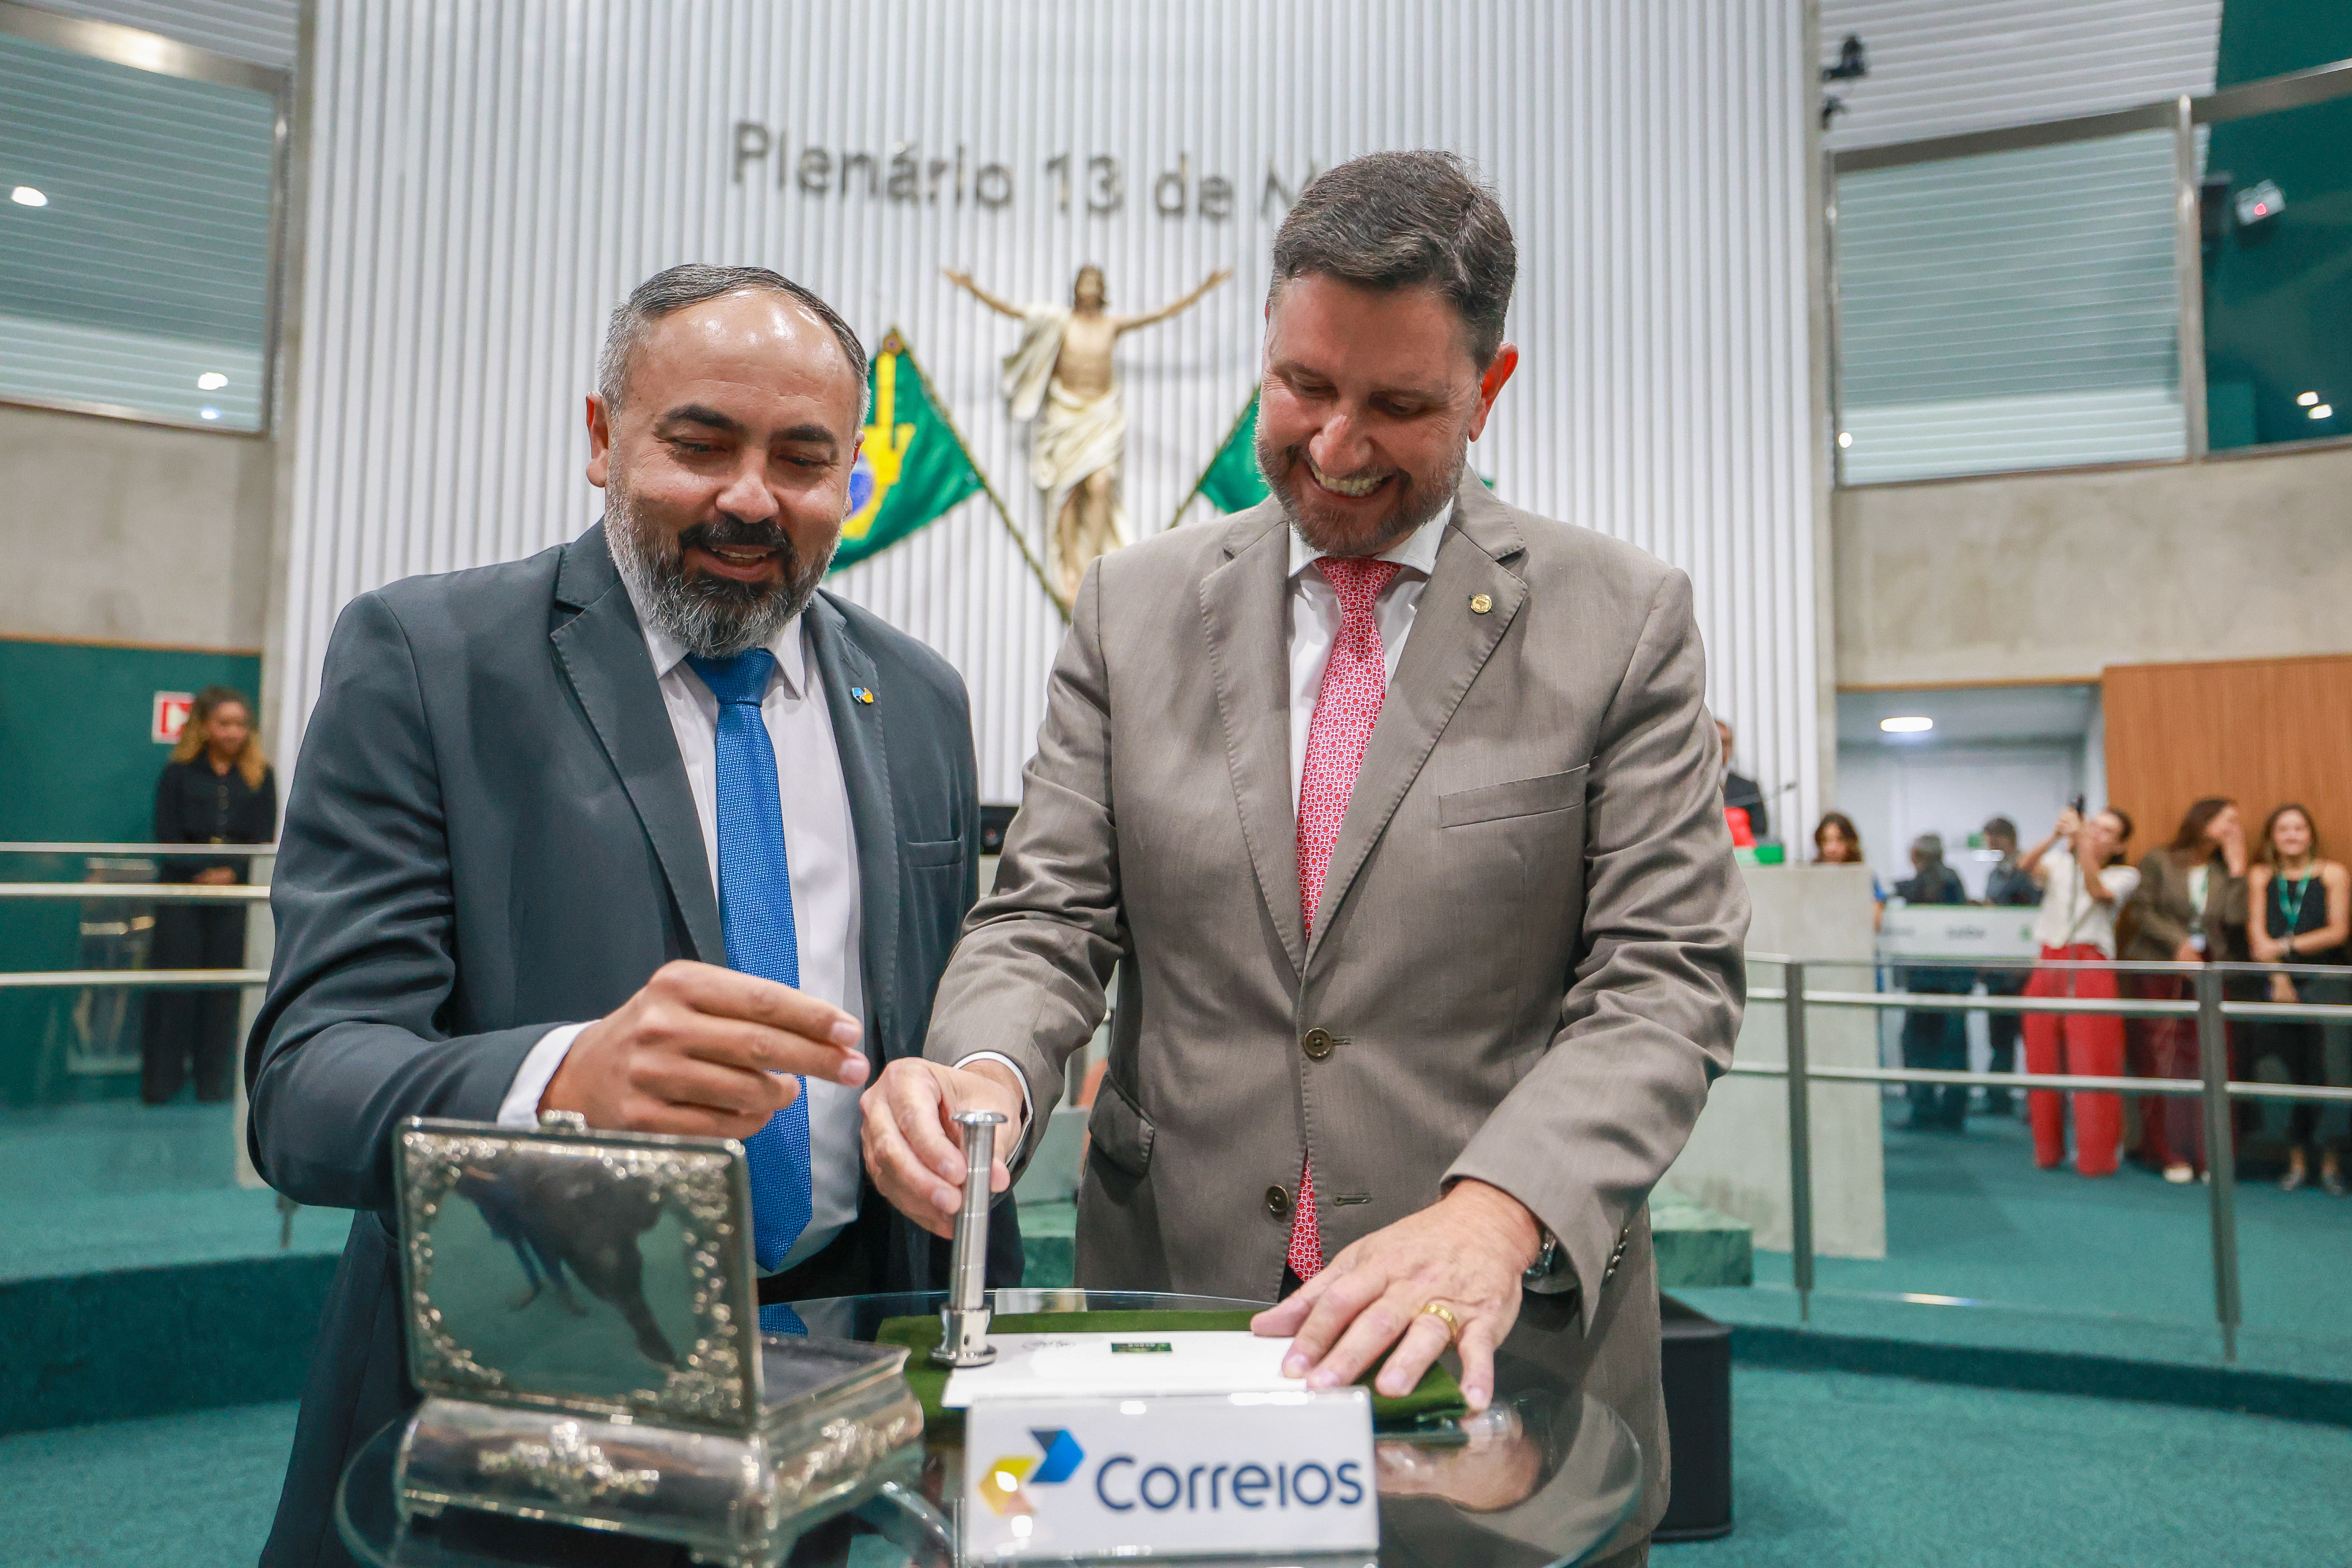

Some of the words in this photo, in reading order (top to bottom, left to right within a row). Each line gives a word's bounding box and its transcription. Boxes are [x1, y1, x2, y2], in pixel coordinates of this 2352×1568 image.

[732, 121, 1012, 208] Plenário
[1045, 154, 1123, 216] 13
[1155, 153, 1234, 220] de
[1095, 1455, 1363, 1511] Correios
